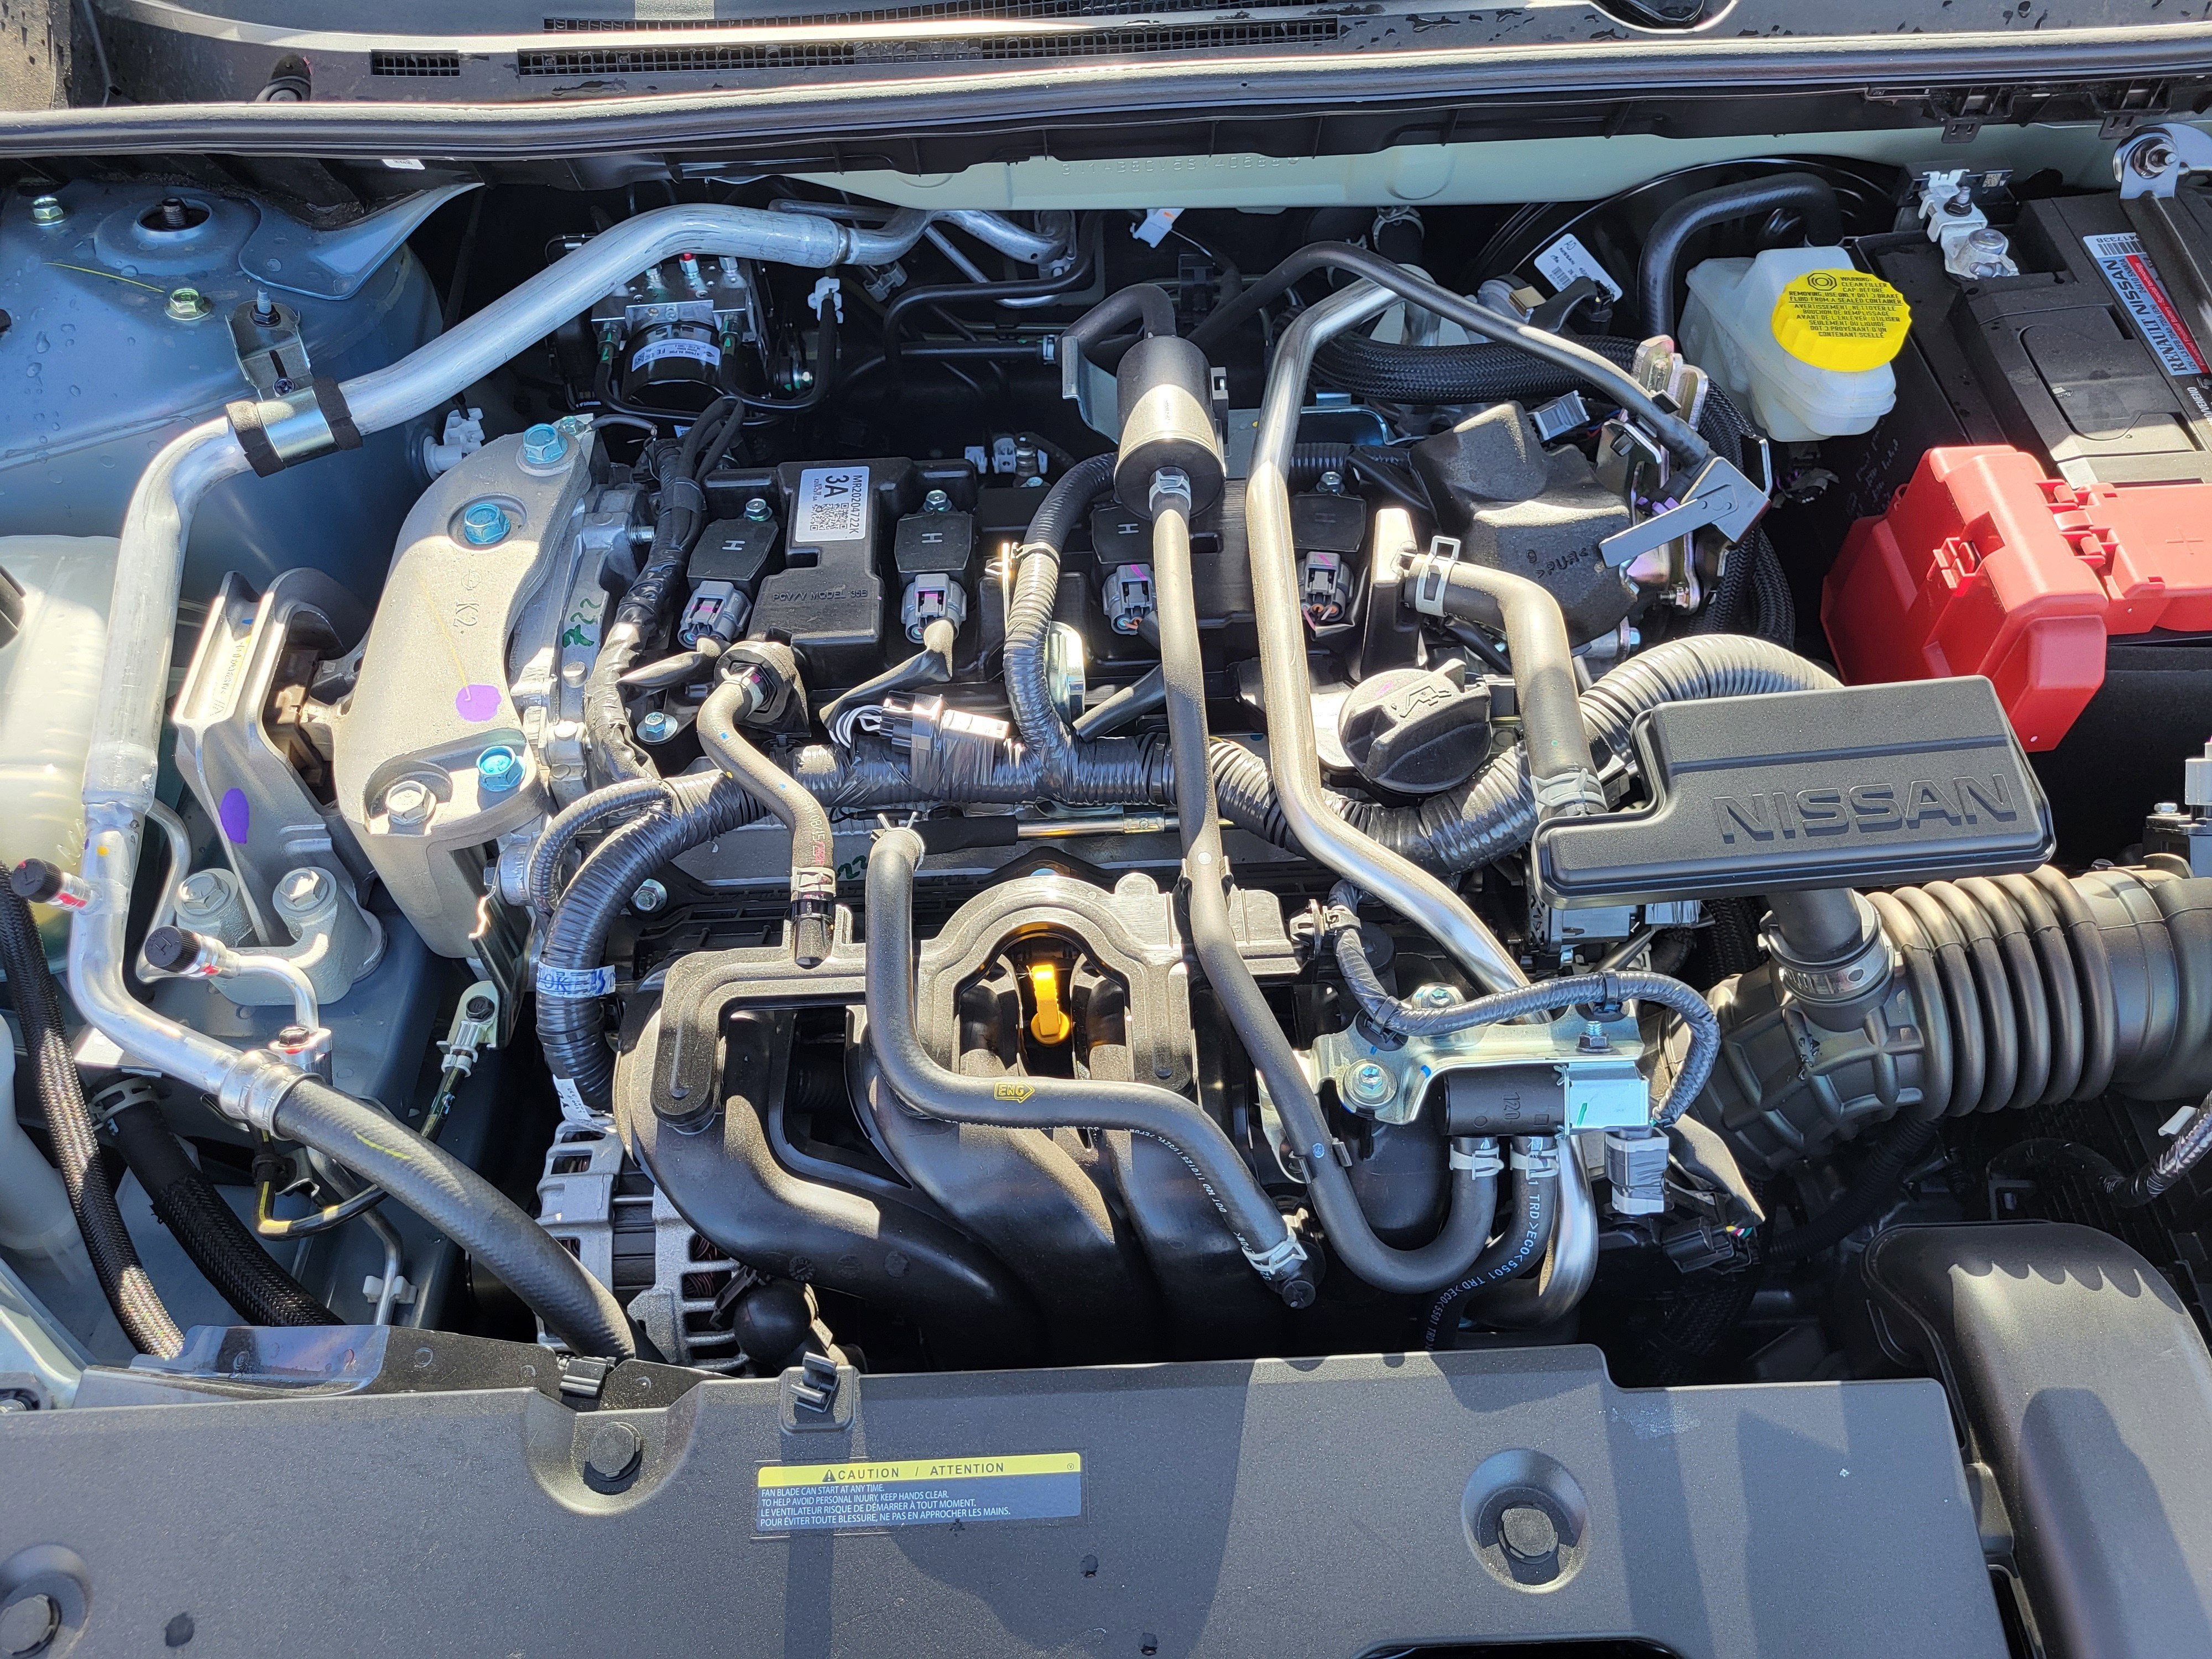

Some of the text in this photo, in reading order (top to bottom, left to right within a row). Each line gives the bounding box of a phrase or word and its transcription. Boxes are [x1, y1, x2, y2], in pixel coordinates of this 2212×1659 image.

[2103, 259, 2188, 372] RENAULT NISSAN
[2173, 340, 2184, 350] EFB
[2187, 360, 2197, 369] 12V
[824, 475, 849, 498] 3A
[849, 475, 863, 534] MR20204722K
[811, 591, 846, 600] MODEL
[1714, 774, 2017, 844] NISSAN
[999, 1084, 1024, 1096] ENG
[1503, 1092, 1520, 1120] 120
[1212, 1197, 1227, 1212] DOT
[838, 1468, 899, 1480] CAUTION
[930, 1463, 1004, 1475] ATTENTION
[762, 1489, 775, 1497] FAN
[777, 1488, 800, 1496] BLADE
[818, 1486, 839, 1494] START
[851, 1484, 865, 1493] ANY
[867, 1484, 885, 1492] TIME.
[762, 1499, 772, 1507] TO
[773, 1498, 791, 1506] HELP
[792, 1497, 814, 1505] AVOID
[816, 1495, 852, 1504] PERSONAL
[854, 1494, 879, 1503] INJURY,
[899, 1491, 924, 1500] HANDS
[925, 1490, 948, 1499] CLEAR.
[761, 1508, 769, 1517] LE
[771, 1506, 822, 1516] VENTILATEUR
[824, 1505, 852, 1514] RISQUE
[865, 1501, 907, 1511] DÉMARRER
[910, 1500, 915, 1509] À
[916, 1500, 937, 1509] TOUT
[940, 1499, 976, 1508] MOMENT.
[760, 1518, 782, 1527] POUR
[784, 1516, 810, 1525] ÉVITER
[811, 1516, 836, 1524] TOUTE
[838, 1514, 878, 1523] BLESSURE,
[892, 1512, 906, 1520] PAS
[908, 1511, 918, 1520] EN
[920, 1509, 967, 1519] APPROCHER
[968, 1509, 982, 1517] LES
[983, 1507, 1010, 1516] MAINS.
